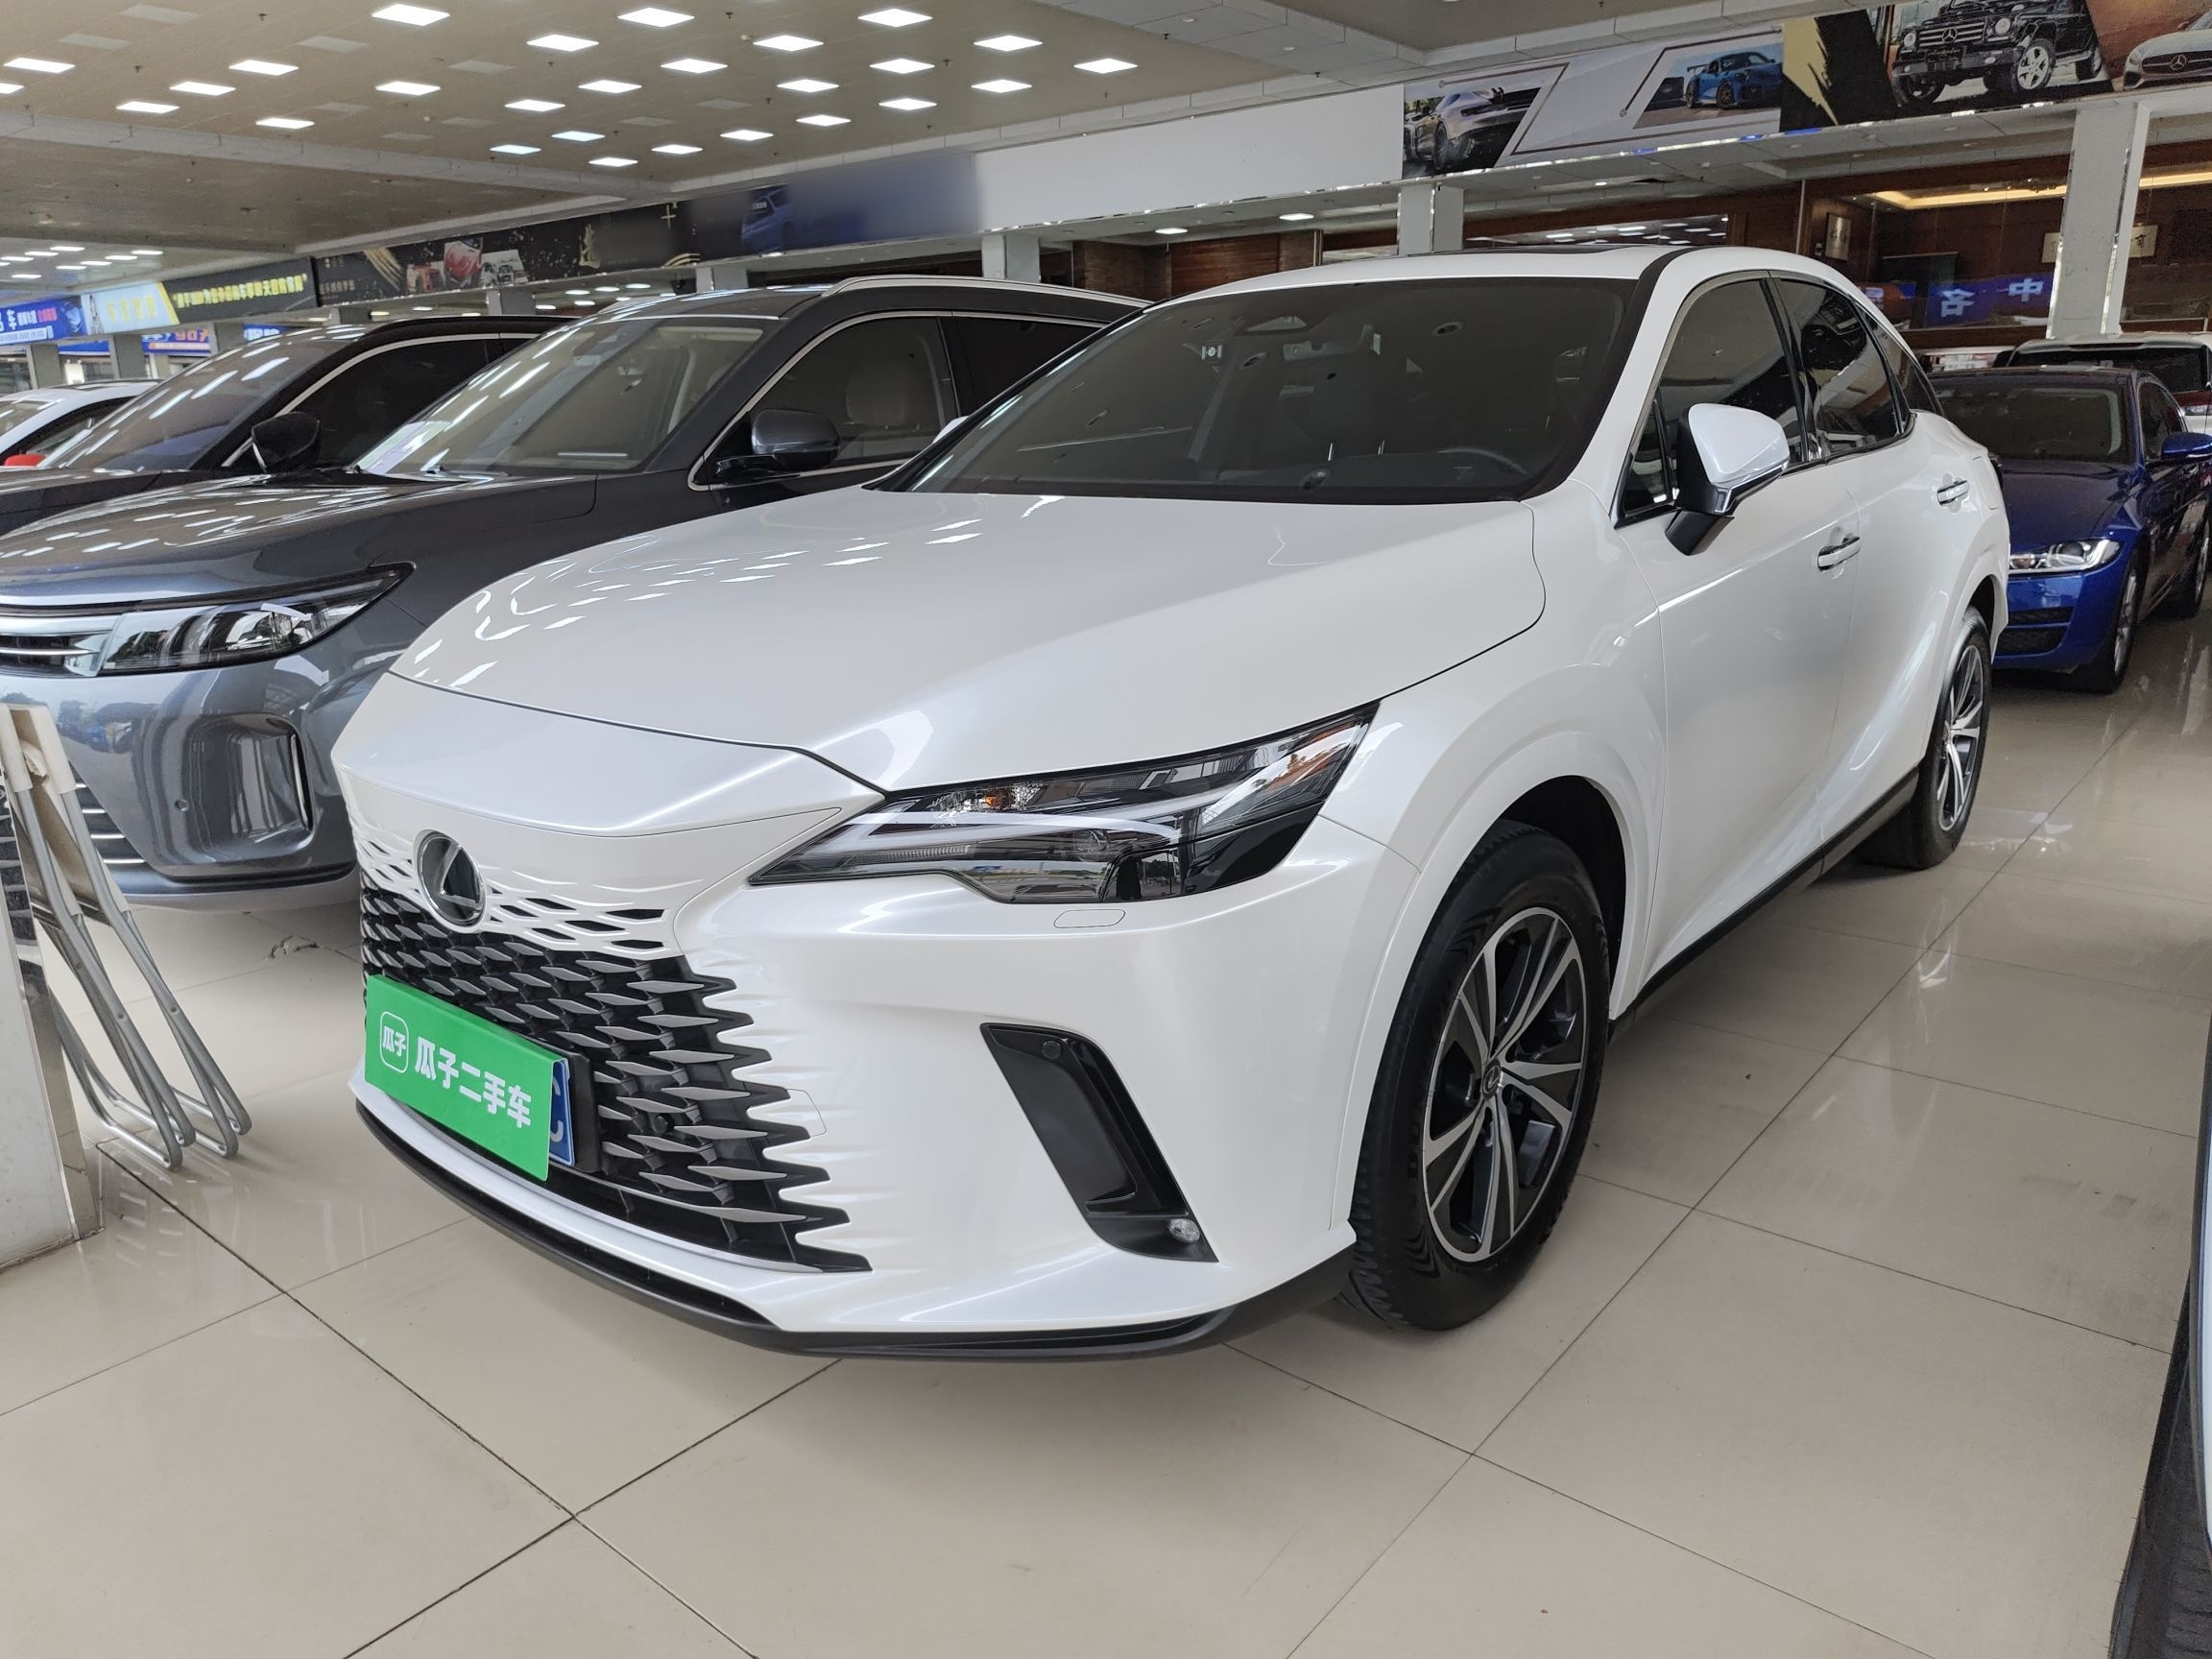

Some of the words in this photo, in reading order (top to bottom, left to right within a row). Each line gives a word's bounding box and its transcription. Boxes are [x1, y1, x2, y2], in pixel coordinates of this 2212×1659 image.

[383, 1026, 407, 1056] 瓜子
[416, 1037, 531, 1128] 瓜子二手车
